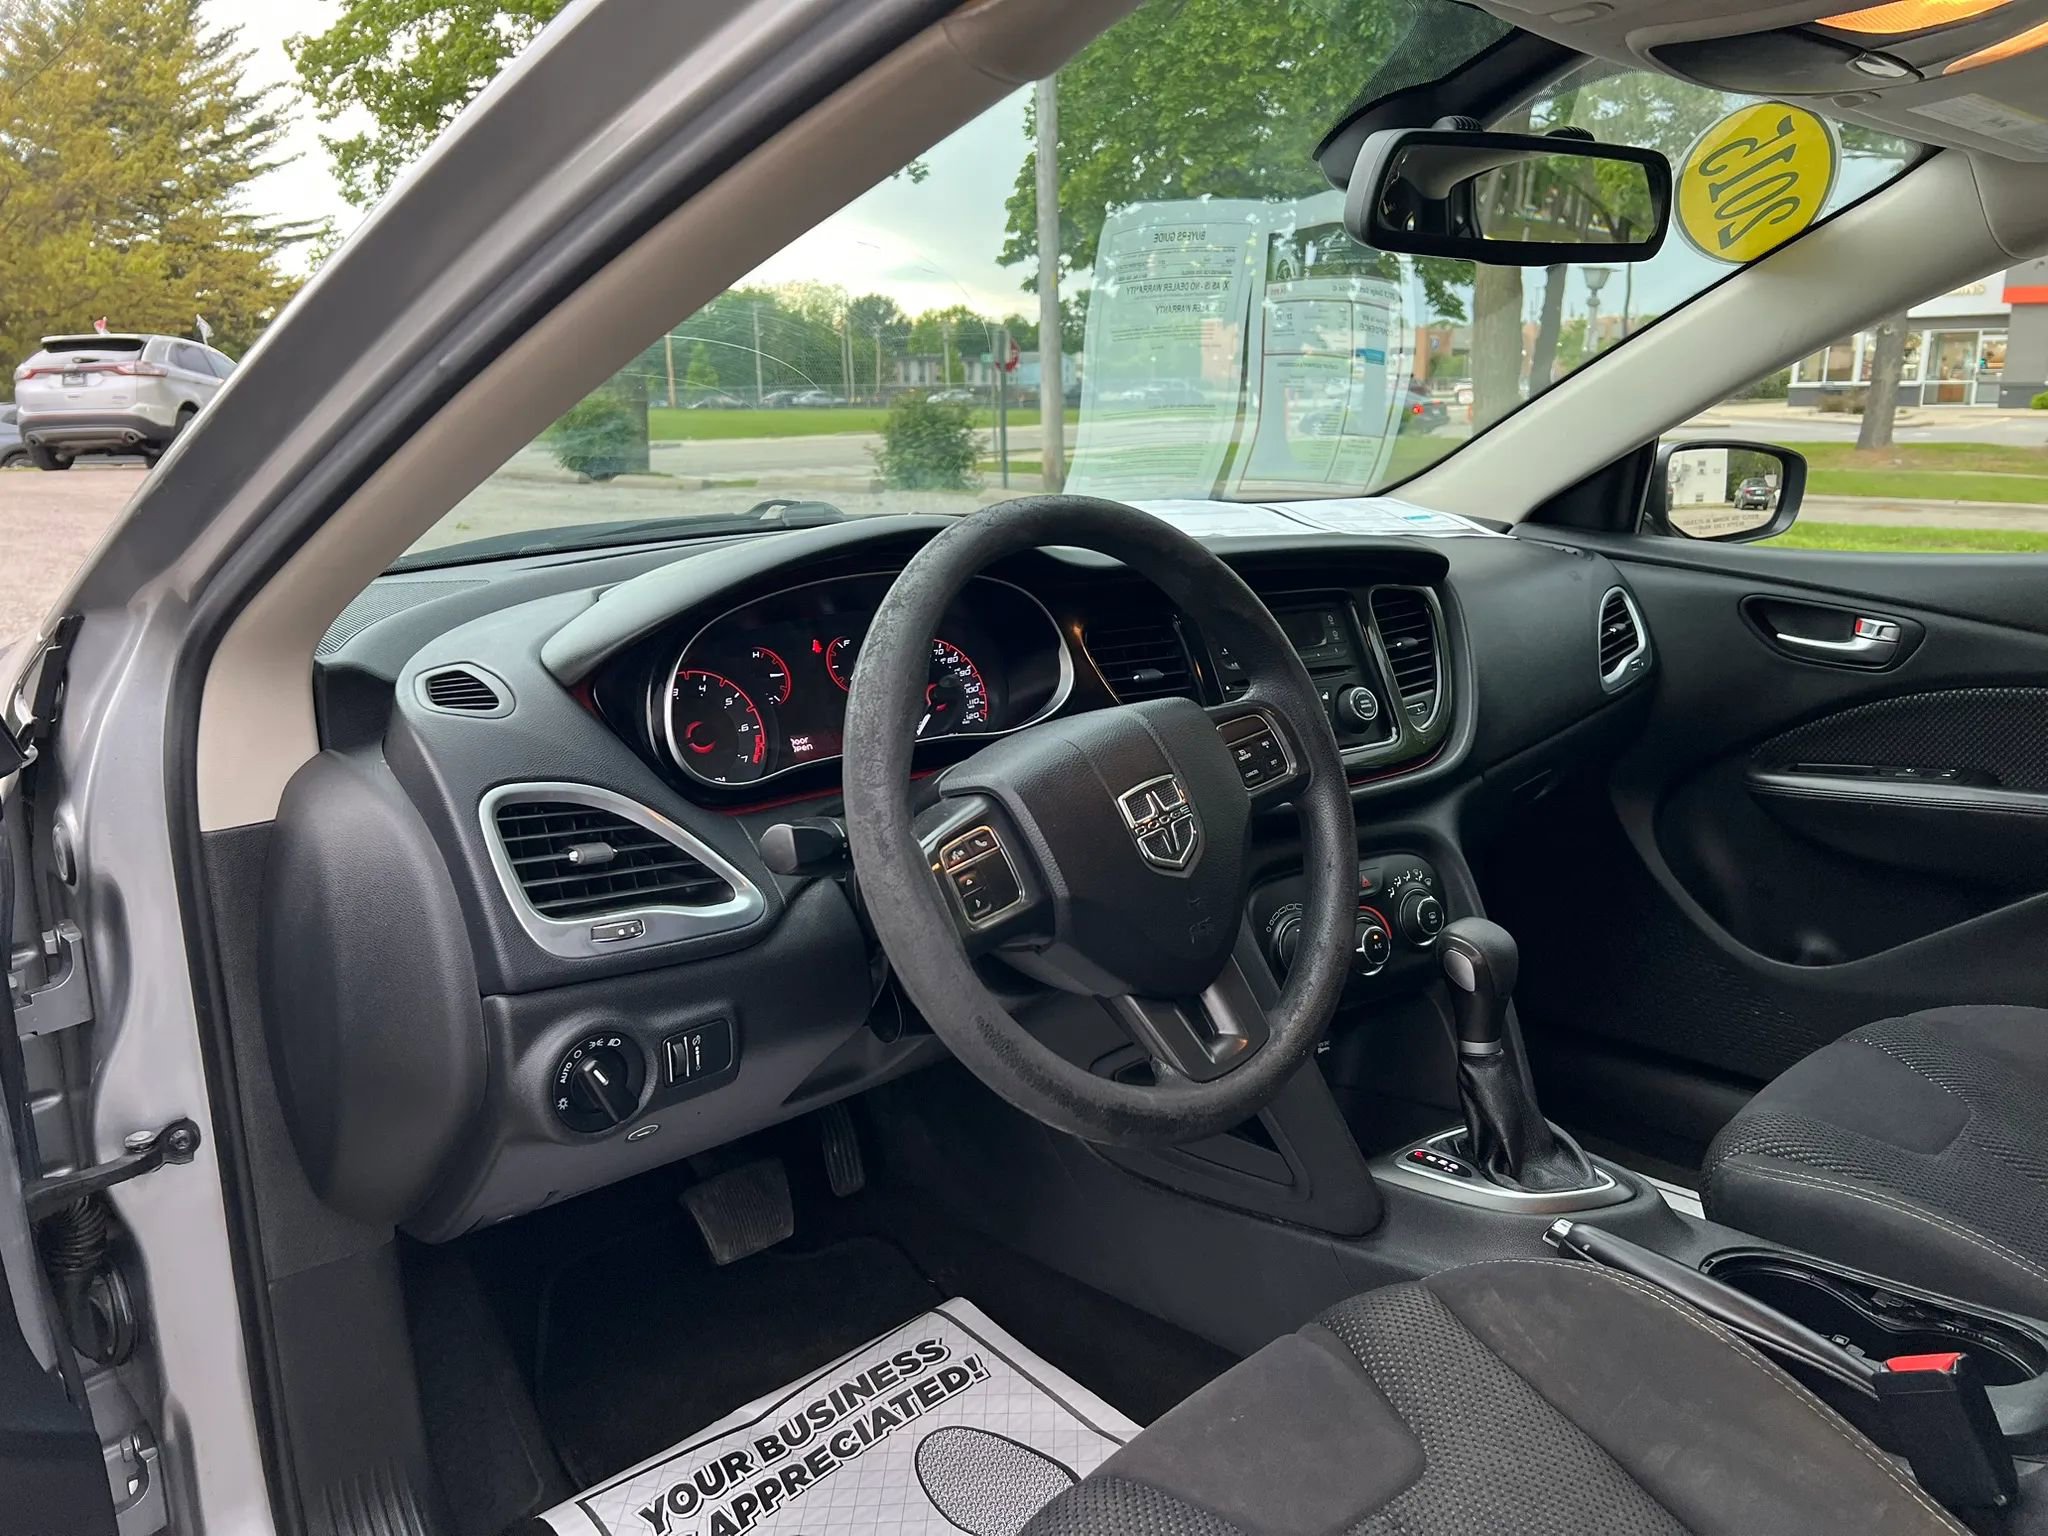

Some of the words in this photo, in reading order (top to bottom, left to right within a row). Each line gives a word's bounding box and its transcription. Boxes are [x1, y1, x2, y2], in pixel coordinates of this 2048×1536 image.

[843, 639, 851, 647] F
[752, 651, 760, 659] H
[933, 648, 944, 656] 70
[698, 684, 706, 693] 4
[965, 685, 979, 694] 100
[725, 697, 733, 706] 5
[740, 723, 749, 732] 6
[740, 755, 749, 763] 7
[1135, 805, 1191, 836] DODGE
[559, 1061, 573, 1084] AUTO
[637, 1450, 758, 1536] YOUR
[752, 1338, 951, 1467] BUSINESS
[704, 1353, 992, 1536] APPRECIATED!
